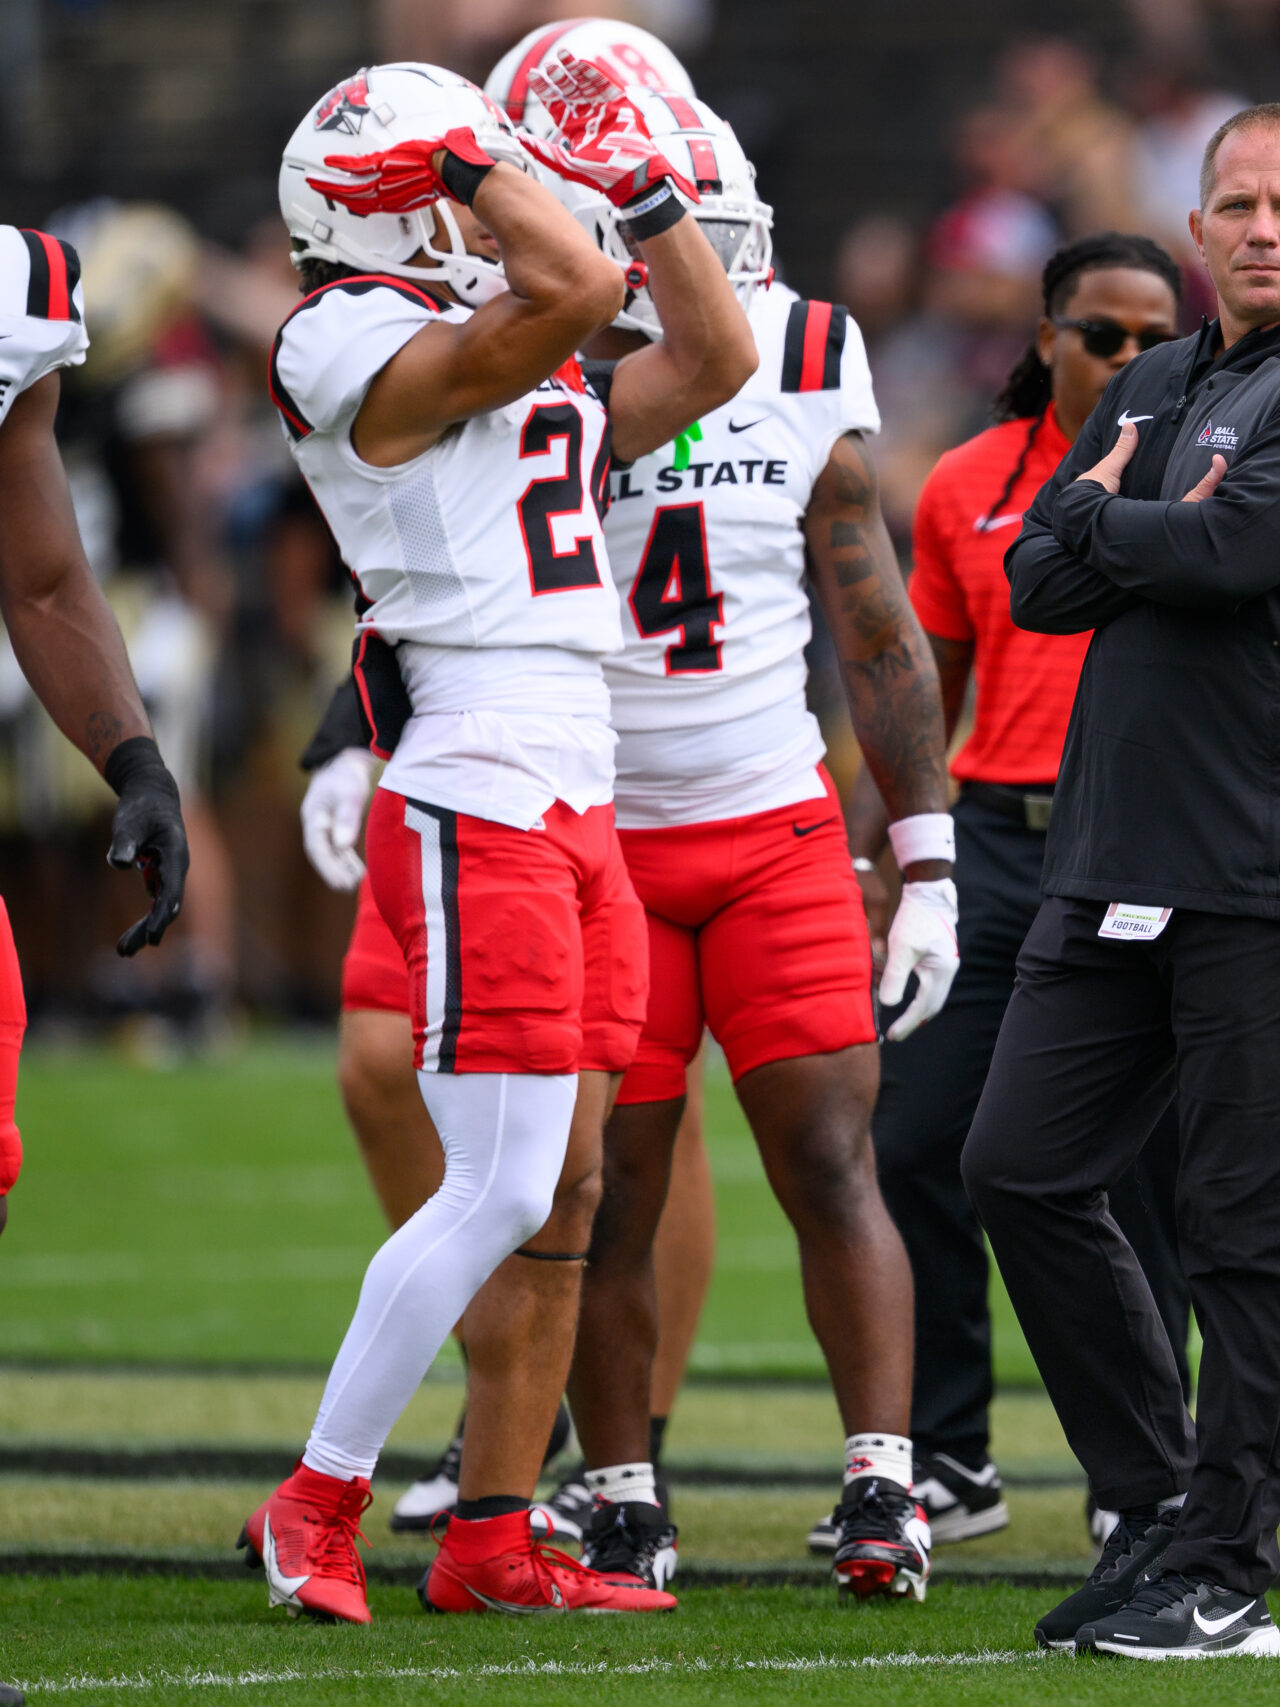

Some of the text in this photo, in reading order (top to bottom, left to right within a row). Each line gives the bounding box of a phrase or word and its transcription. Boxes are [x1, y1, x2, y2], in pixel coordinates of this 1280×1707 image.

[1214, 426, 1235, 435] BALL
[1210, 435, 1239, 445] STATE
[656, 460, 788, 492] STATE
[627, 501, 726, 677] 4
[1112, 920, 1153, 933] FOOTBALL
